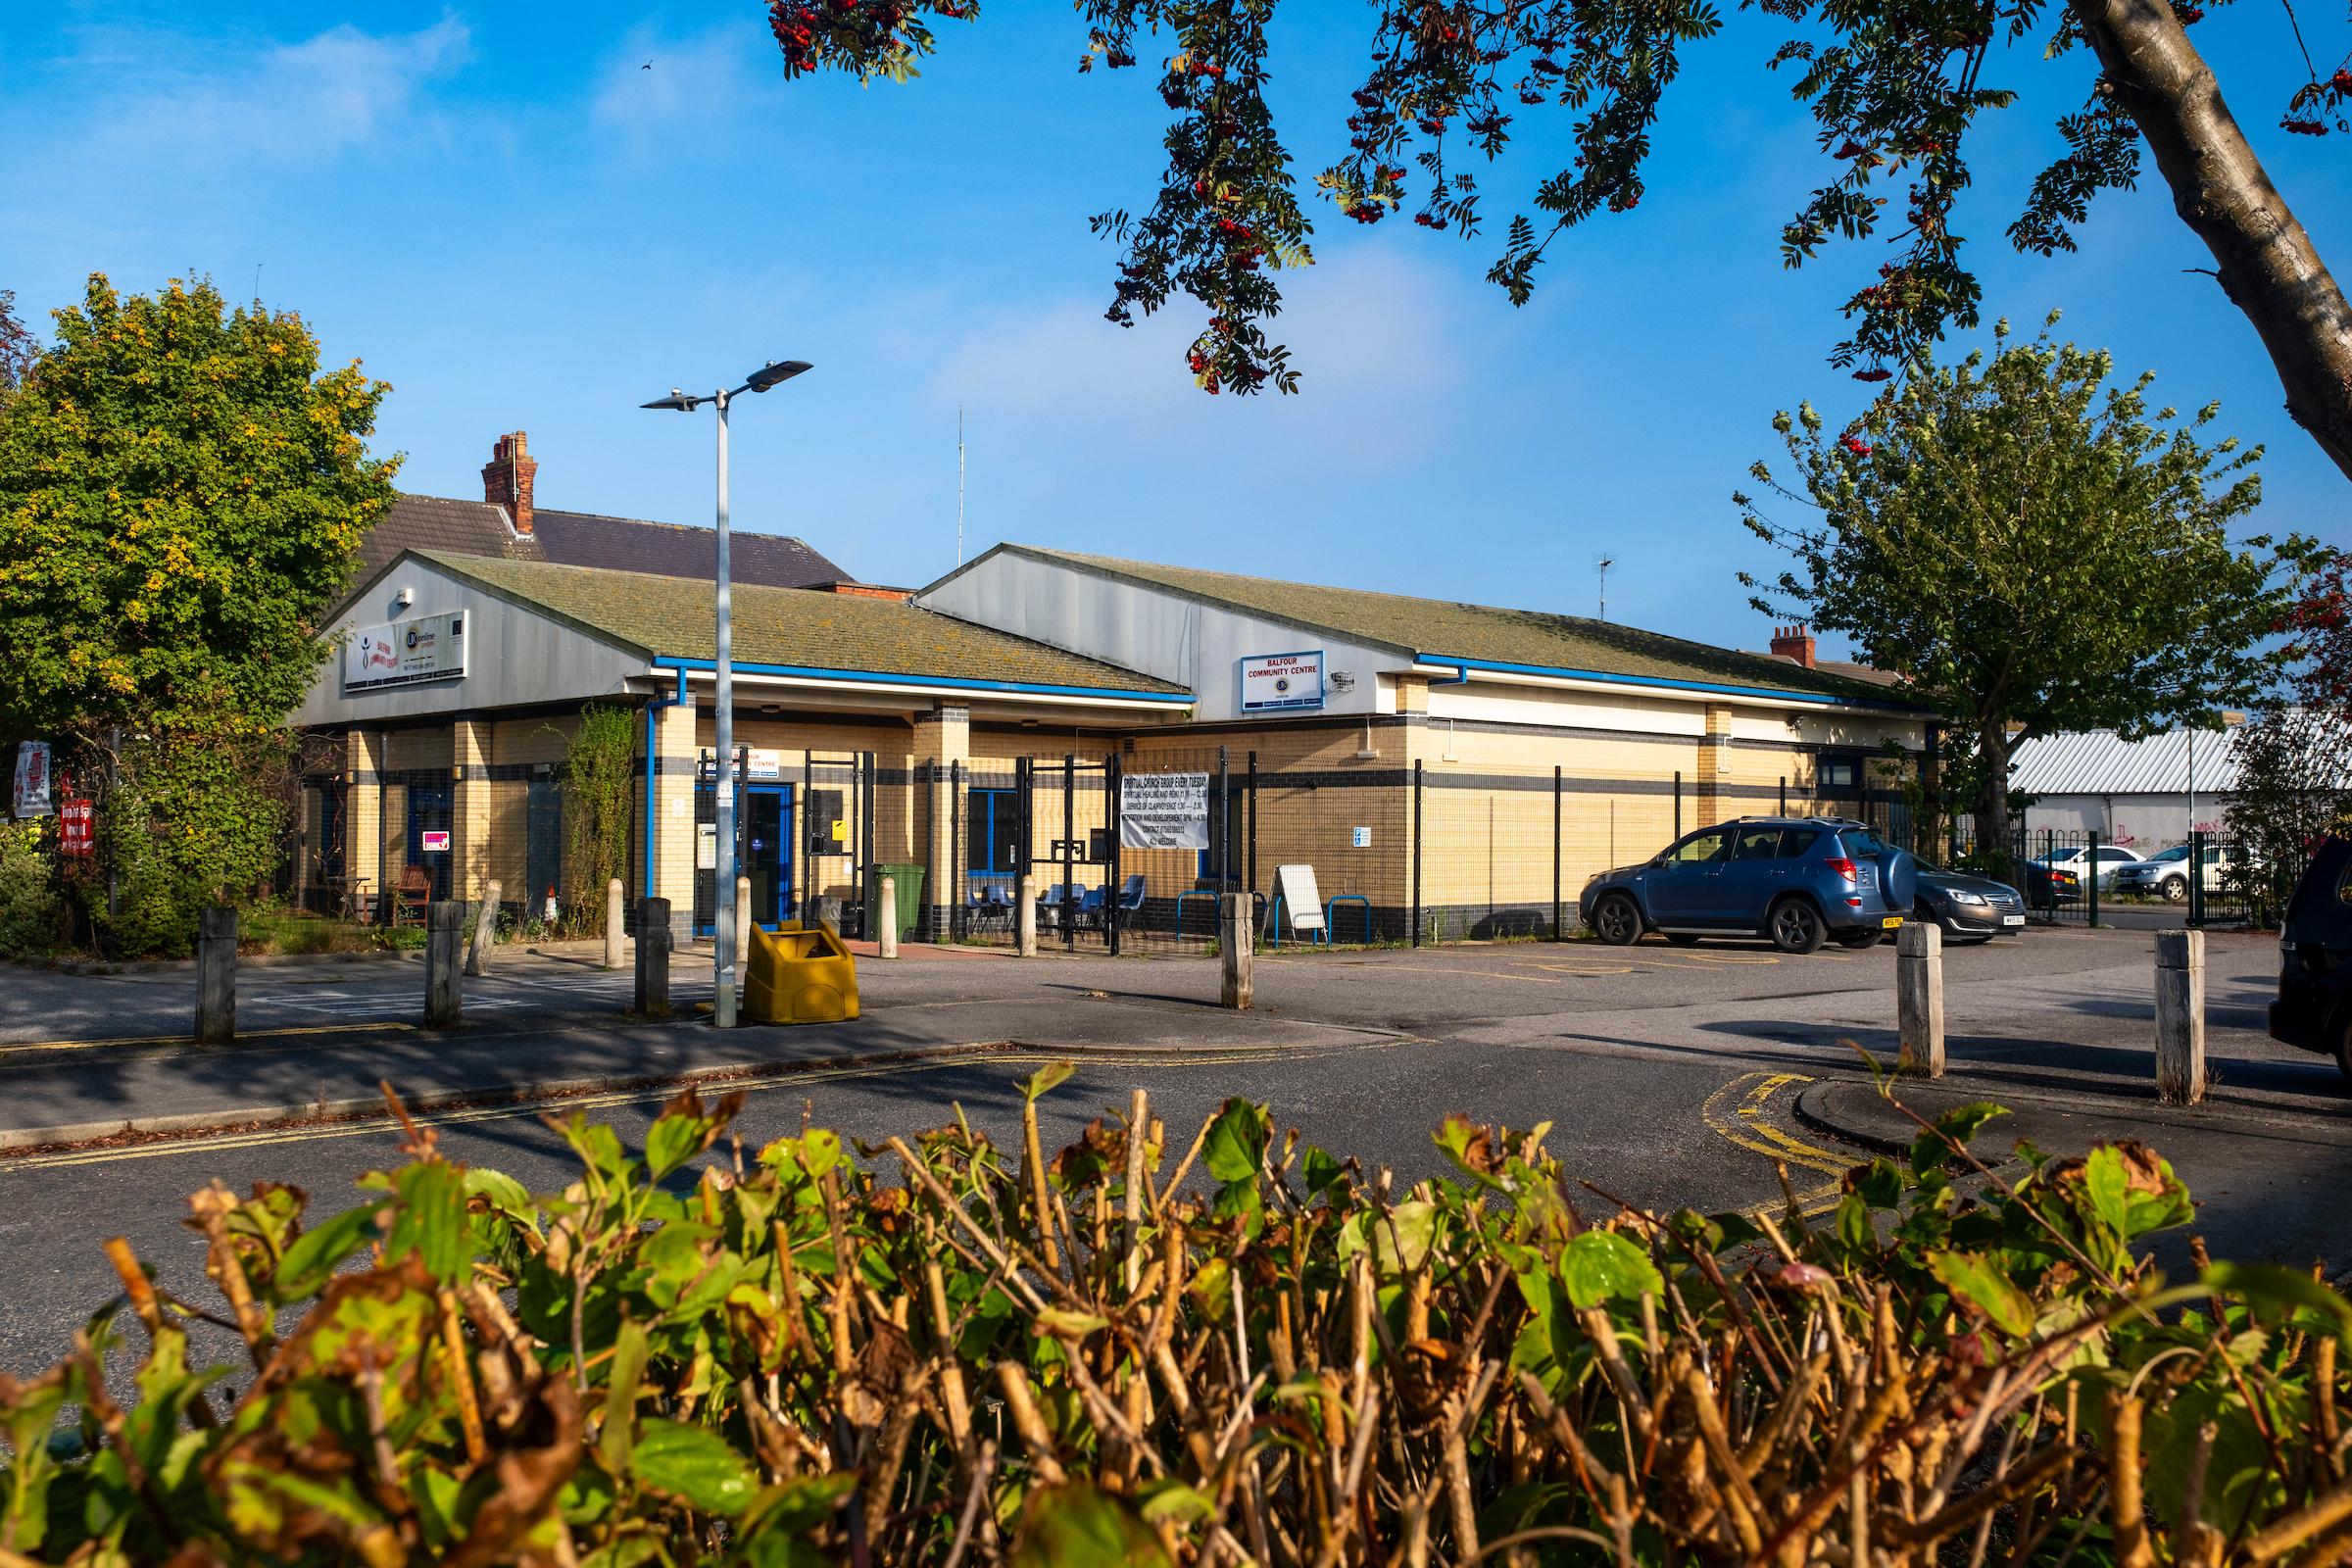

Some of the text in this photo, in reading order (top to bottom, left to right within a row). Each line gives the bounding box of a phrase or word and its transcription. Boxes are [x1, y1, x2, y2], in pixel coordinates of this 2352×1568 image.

[417, 632, 435, 642] online
[1267, 658, 1298, 666] BALFOUR
[1249, 665, 1318, 677] COMMUNITY CENTRE
[1124, 776, 1206, 788] SPIRITUAL CHURCH GROUP EVERY TUESDAY
